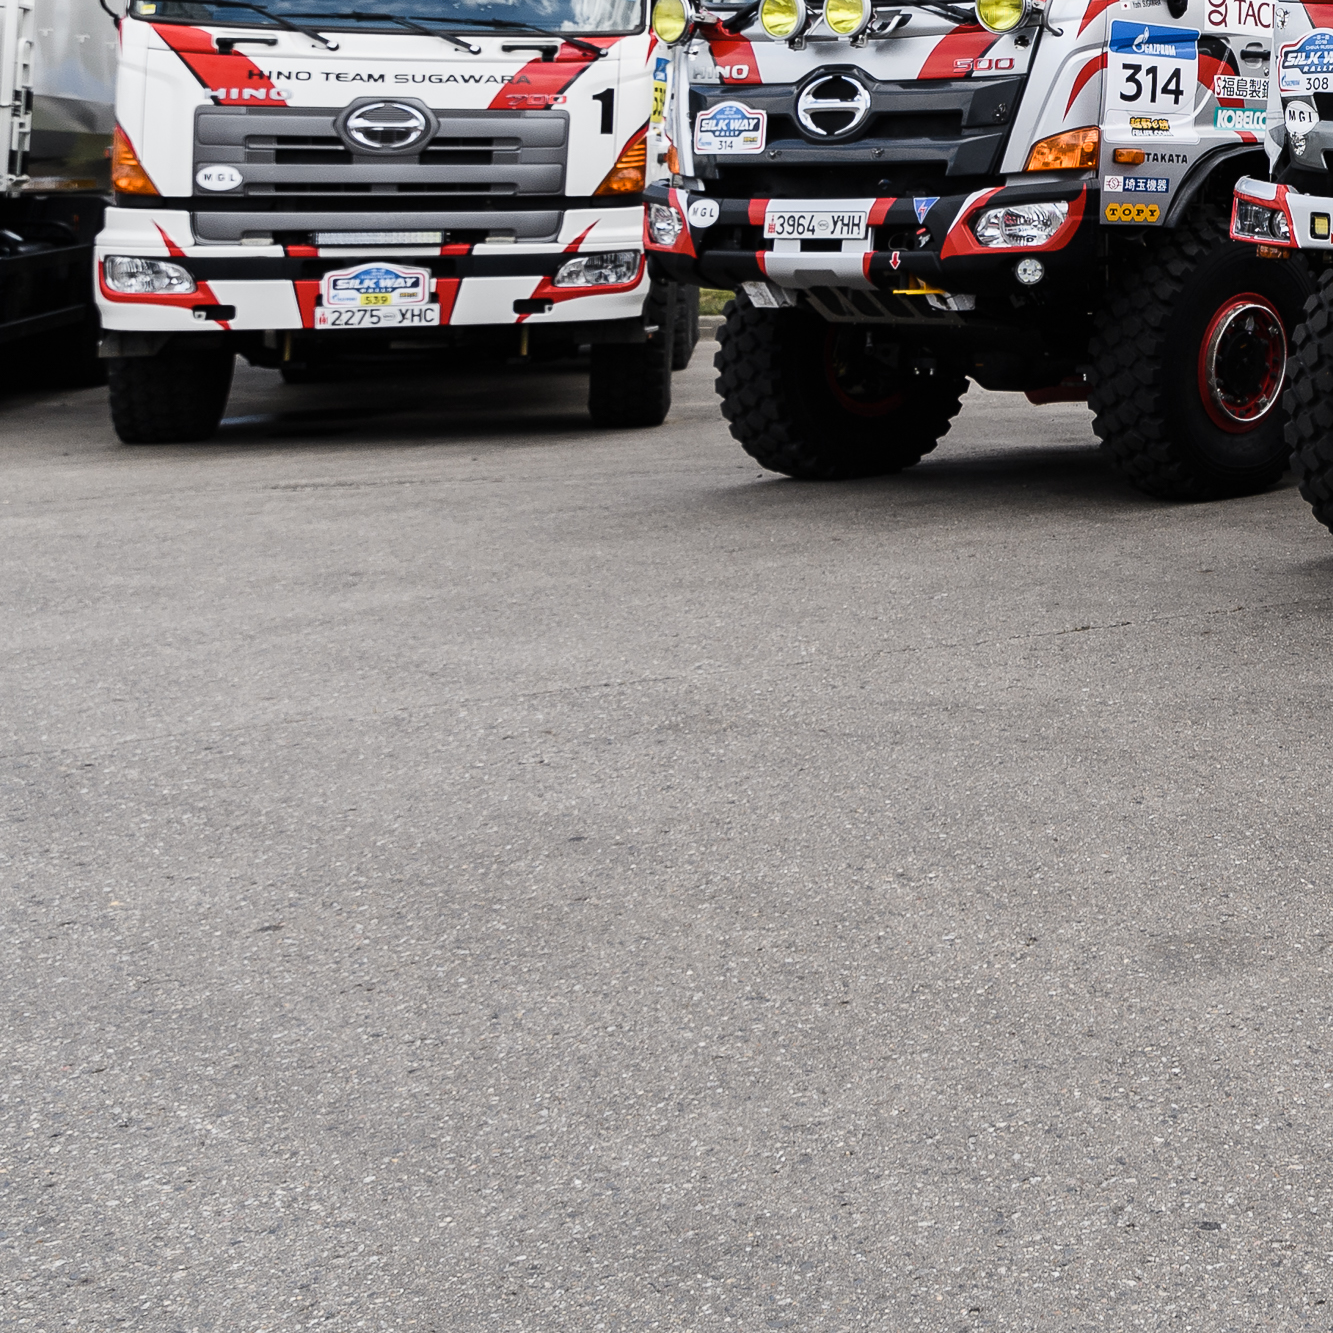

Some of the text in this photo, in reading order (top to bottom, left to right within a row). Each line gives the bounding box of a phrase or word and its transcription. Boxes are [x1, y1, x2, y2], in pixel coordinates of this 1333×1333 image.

[953, 56, 1015, 73] 500
[1284, 51, 1322, 67] SILK
[248, 69, 531, 86] HINO TEAM SUGAWARA
[692, 64, 750, 80] HINO
[1119, 62, 1184, 105] 314
[1305, 77, 1329, 91] 308
[203, 86, 293, 102] HINO
[505, 92, 568, 106] 700
[592, 87, 615, 135] 1
[700, 118, 758, 131] SILK WAY
[717, 140, 734, 151] 314
[1145, 152, 1188, 165] TAKATA
[204, 173, 237, 183] MGL
[1124, 178, 1168, 192] 埼玉機器
[692, 206, 715, 218] MGL
[1109, 207, 1158, 217] TOPY
[776, 215, 816, 236] 3964
[335, 277, 417, 290] SILK WAY
[365, 295, 389, 305] 539
[331, 308, 381, 326] 2275
